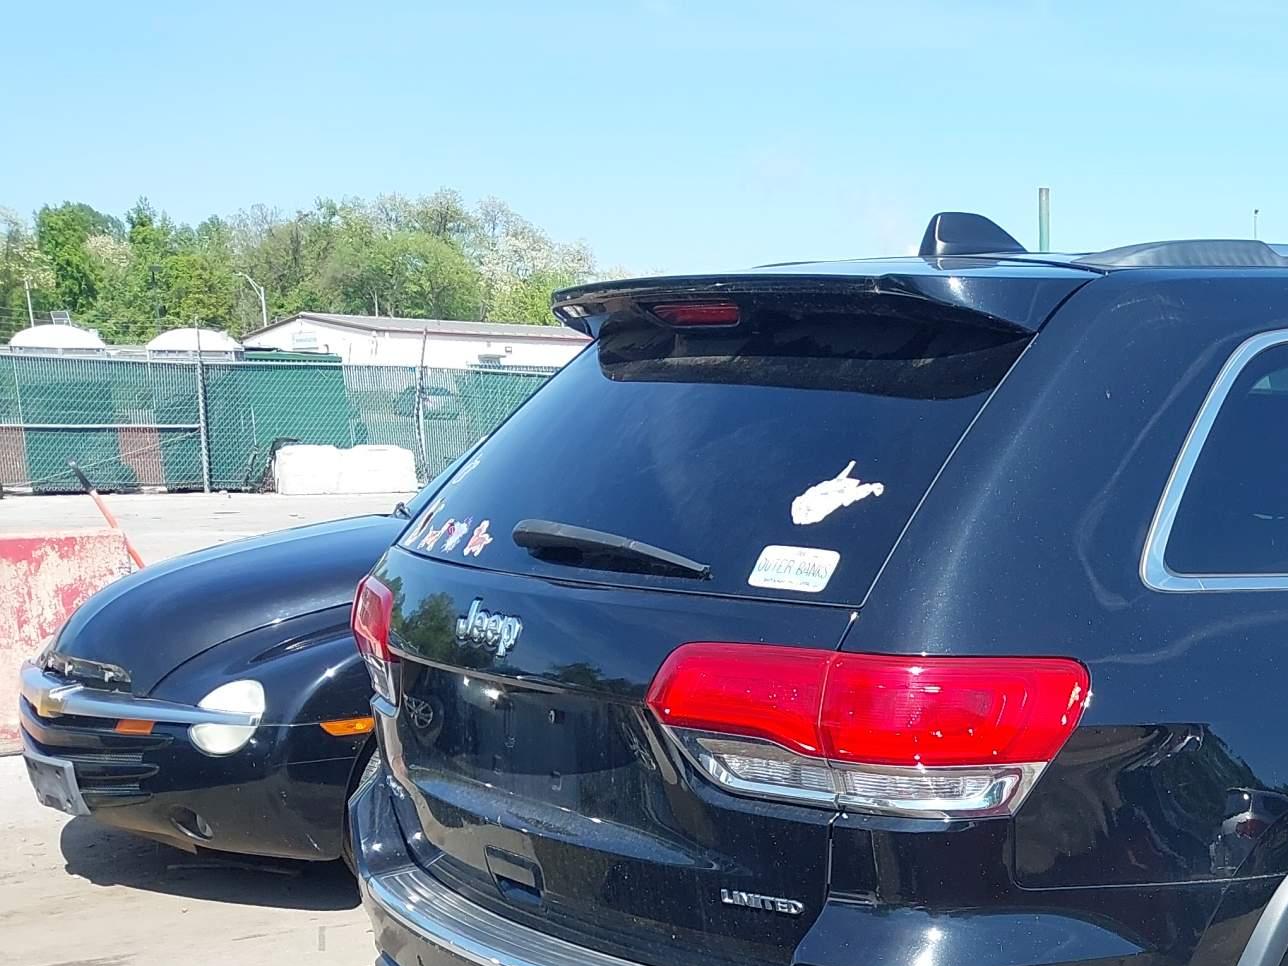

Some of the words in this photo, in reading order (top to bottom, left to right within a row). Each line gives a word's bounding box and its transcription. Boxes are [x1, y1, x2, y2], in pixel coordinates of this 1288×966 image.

[758, 557, 795, 575] OUTER
[456, 597, 523, 658] Jeep
[720, 888, 805, 915] LIMITED
